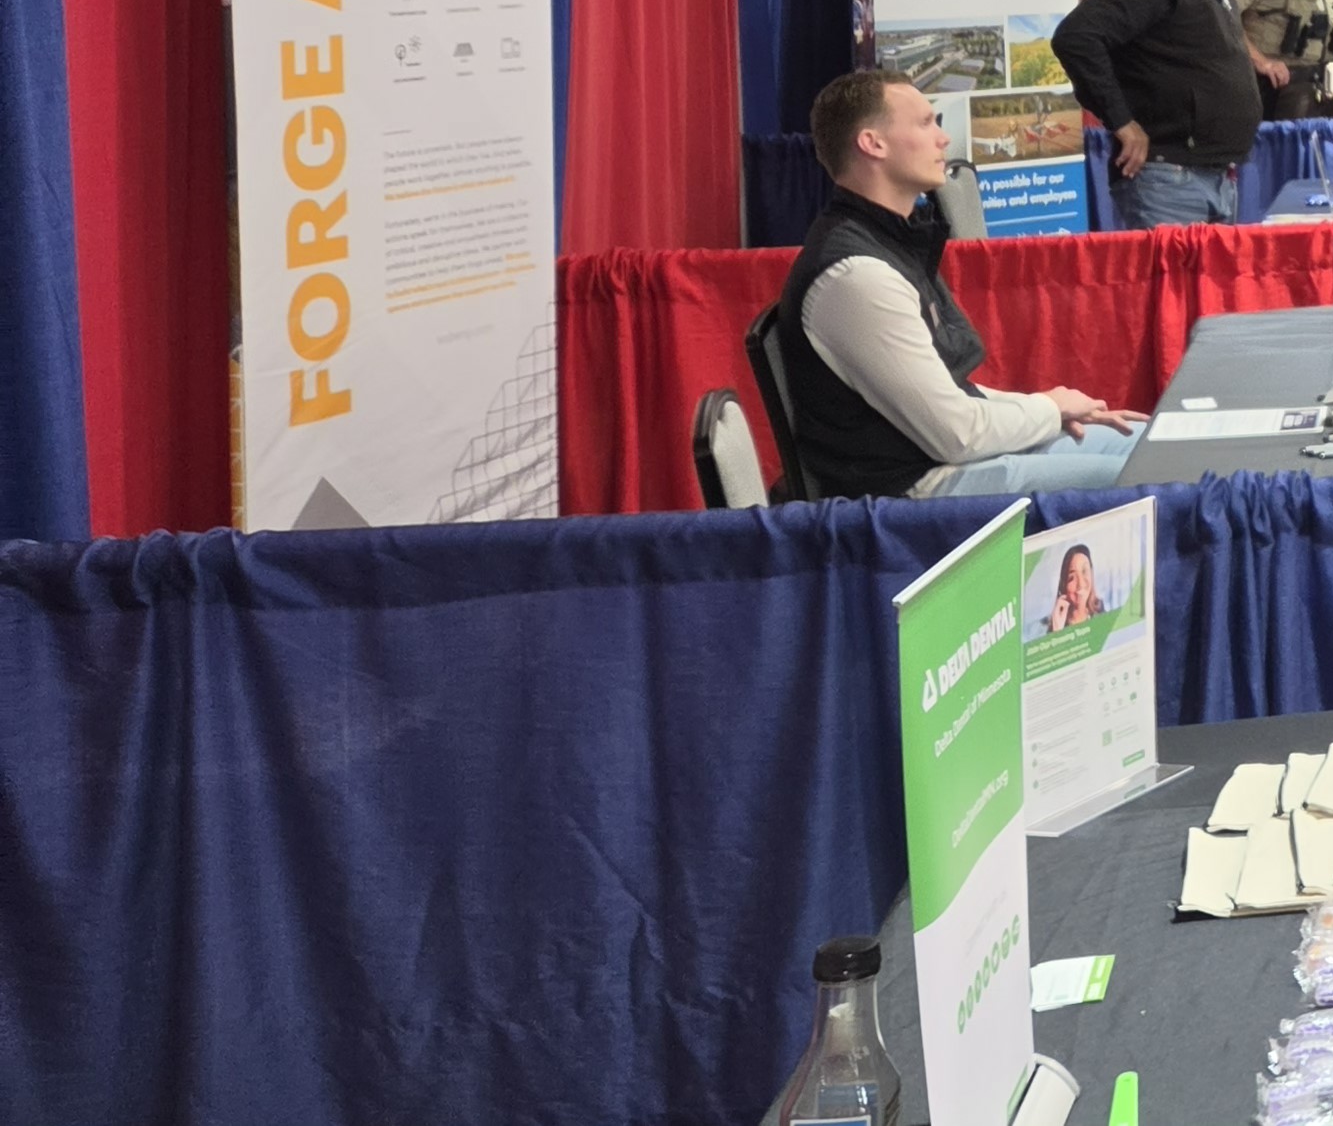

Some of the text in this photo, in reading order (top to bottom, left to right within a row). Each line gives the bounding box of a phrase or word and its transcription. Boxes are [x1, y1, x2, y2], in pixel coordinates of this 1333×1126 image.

[993, 174, 1031, 192] possible
[1033, 172, 1046, 186] for
[1049, 174, 1065, 184] our
[1009, 191, 1028, 207] and
[1030, 189, 1077, 206] employees
[280, 34, 353, 428] FORGE
[938, 641, 971, 698] DELTA
[934, 731, 954, 759] Delta
[977, 669, 1012, 709] Minnesota
